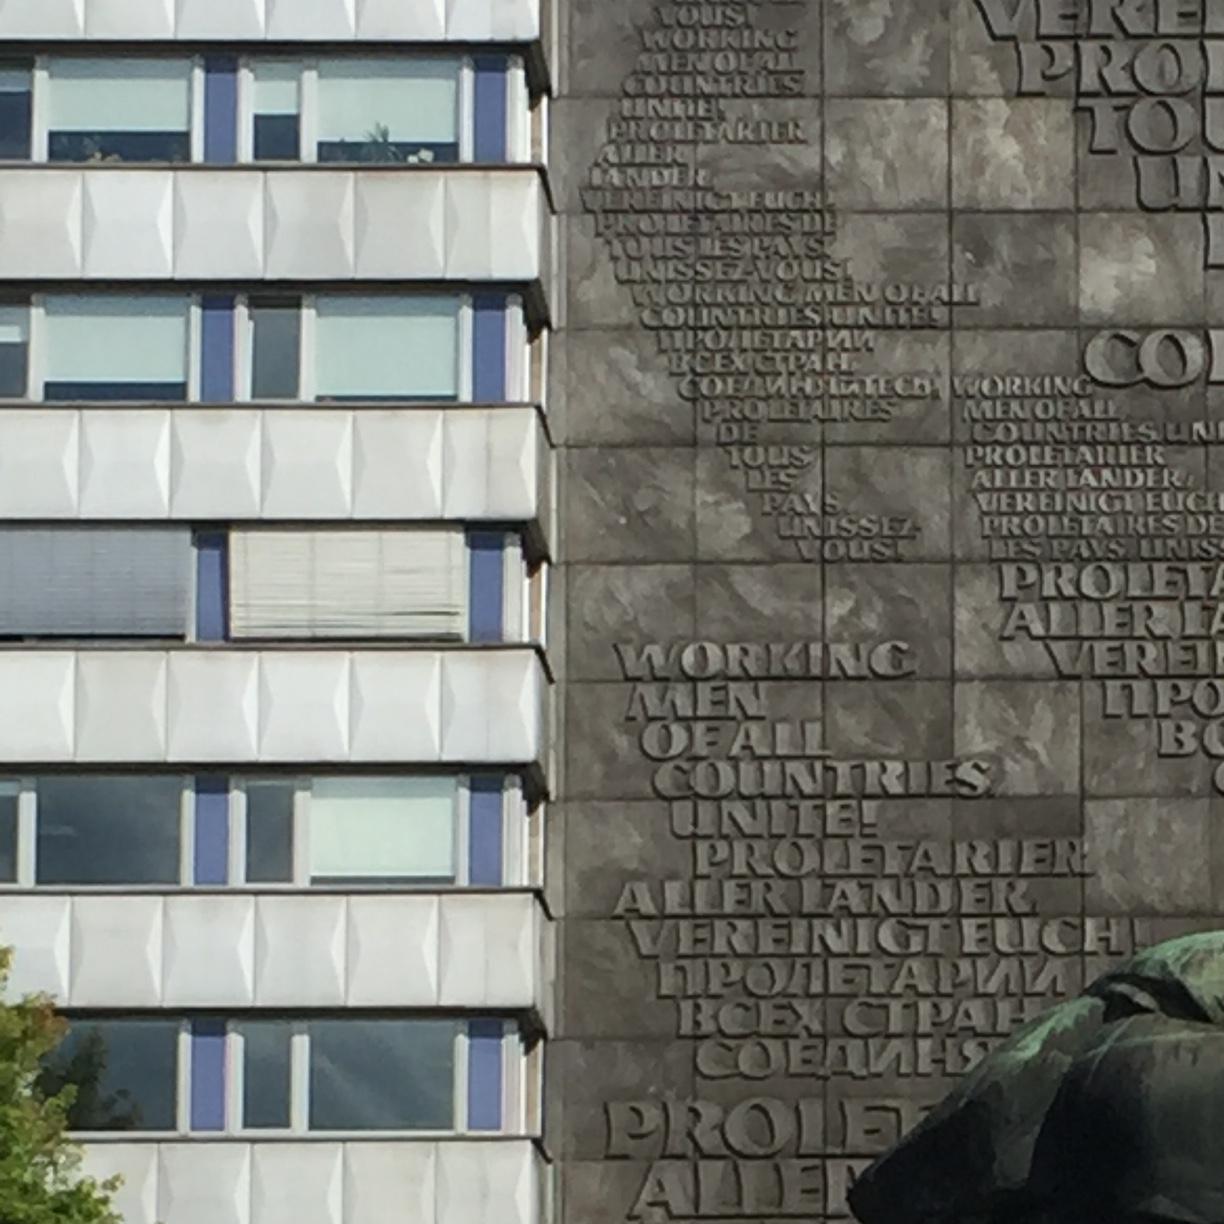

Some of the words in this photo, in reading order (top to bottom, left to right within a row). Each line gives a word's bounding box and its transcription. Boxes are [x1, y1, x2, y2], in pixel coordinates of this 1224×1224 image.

[951, 375, 1093, 398] WORKING
[964, 445, 1167, 468] PROLETARIER
[999, 600, 1173, 640] ALLER
[612, 643, 917, 681] WORKING
[625, 683, 767, 721] MEN
[639, 721, 720, 759] OF
[729, 721, 831, 759] ALL
[654, 759, 992, 798] COUNTRIES
[670, 800, 878, 838] UNITE!
[693, 840, 1096, 878] PROLETARIER
[611, 880, 790, 919] ALLER
[627, 918, 951, 959] VEREINIGT
[658, 958, 1066, 998] ПРОЛЕТАРИИ
[676, 1000, 827, 1039] ВСЕХ
